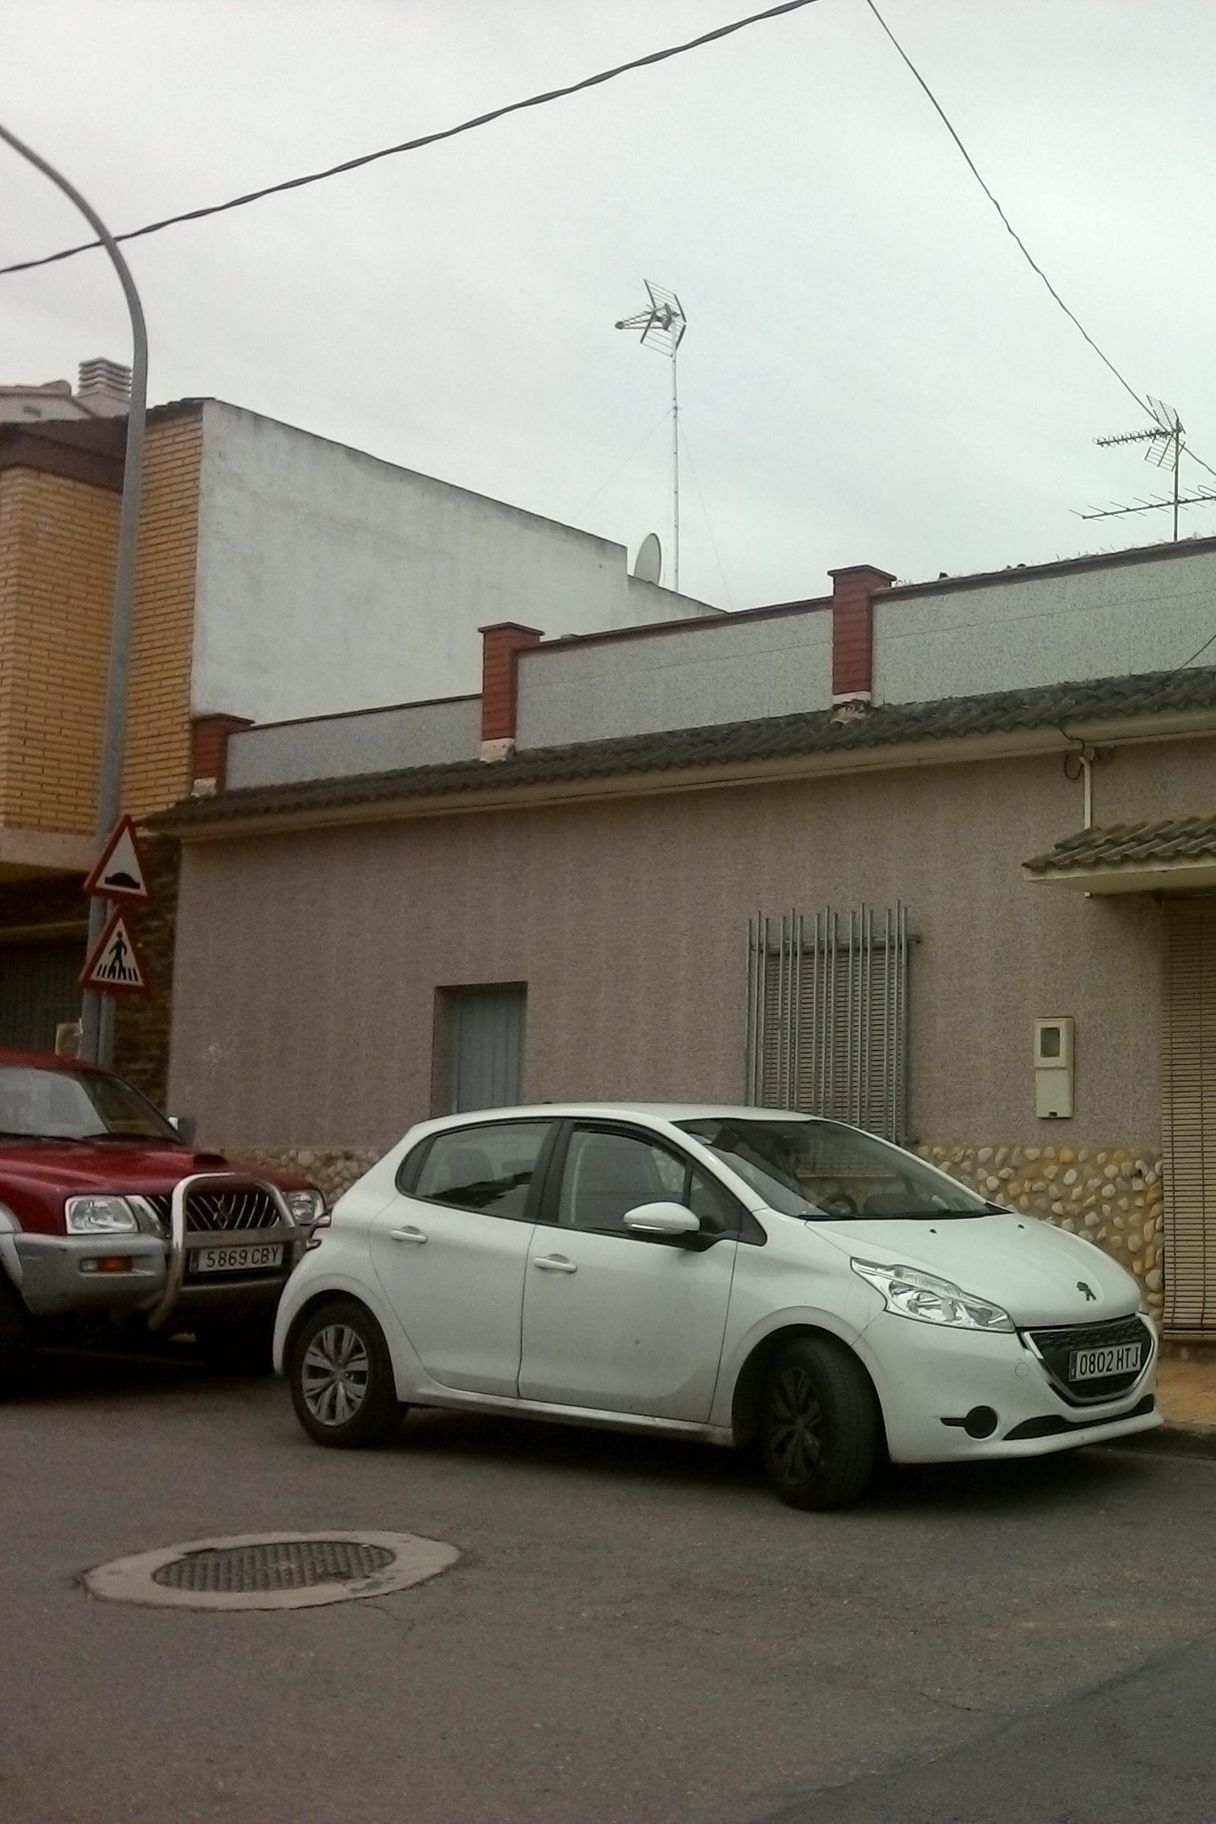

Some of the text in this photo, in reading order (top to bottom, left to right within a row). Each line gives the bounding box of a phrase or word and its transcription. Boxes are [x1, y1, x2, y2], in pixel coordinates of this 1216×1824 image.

[206, 1246, 278, 1268] 5869 CBY
[1080, 1346, 1139, 1376] 0802 HTJ
